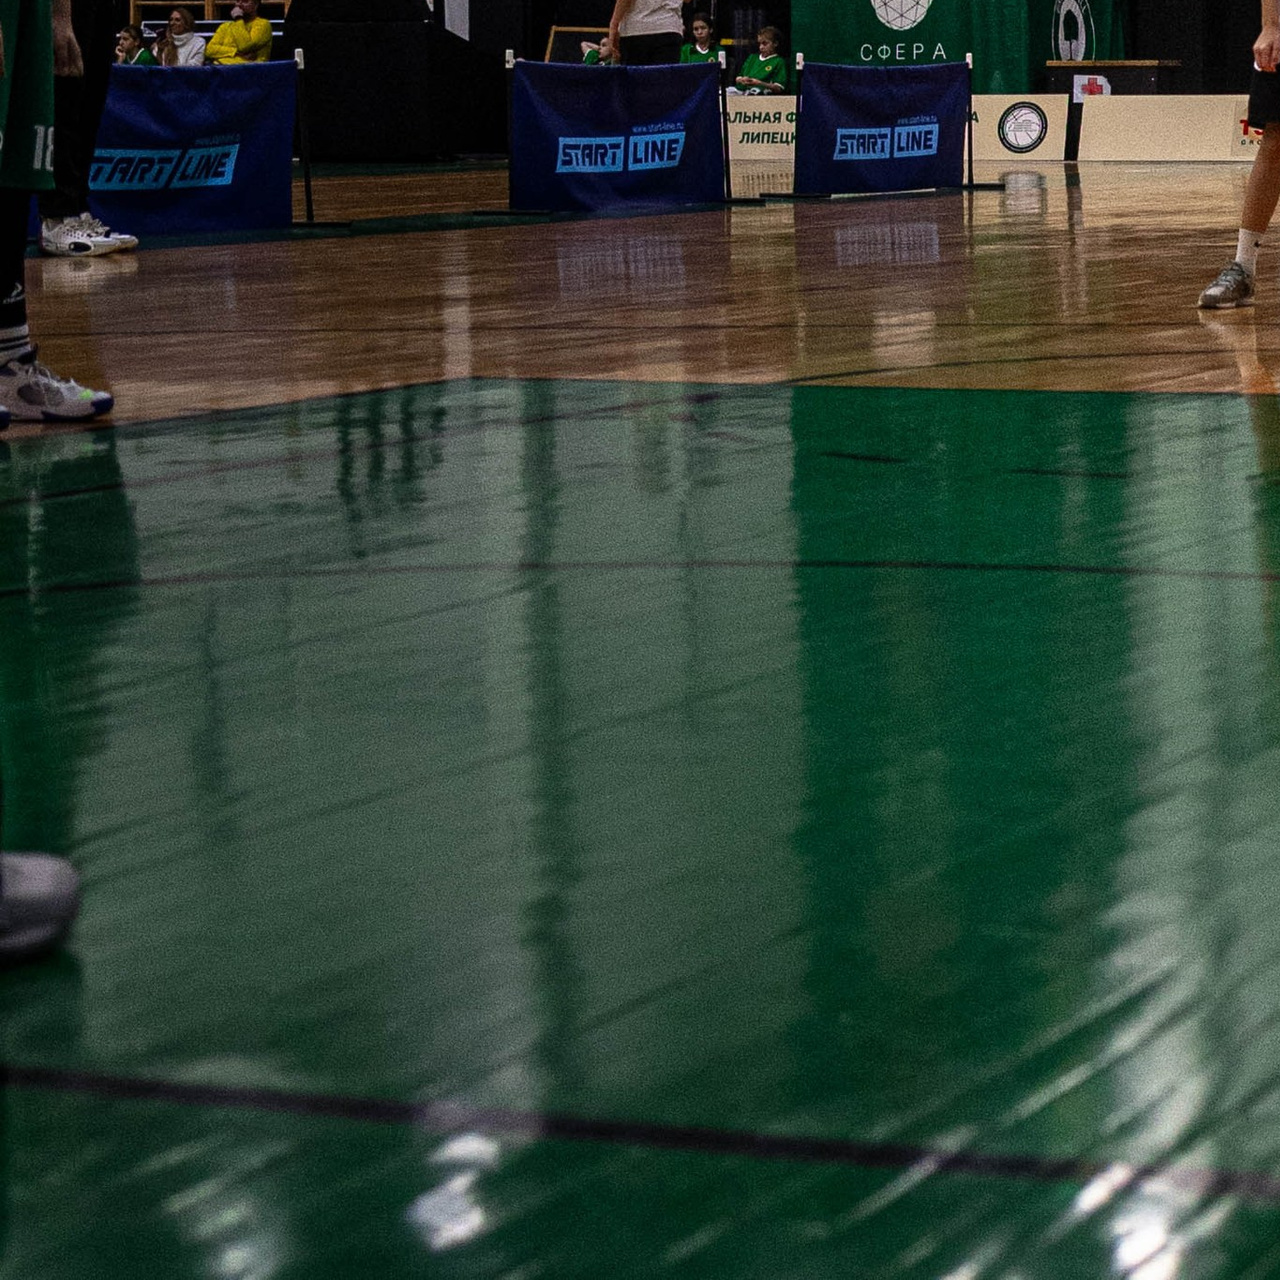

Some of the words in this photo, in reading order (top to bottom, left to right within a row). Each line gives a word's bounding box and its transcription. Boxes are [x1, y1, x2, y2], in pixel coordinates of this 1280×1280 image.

[860, 42, 947, 61] СФЕРА
[561, 143, 621, 166] START
[632, 138, 680, 164] LINE
[837, 133, 889, 155] START
[897, 130, 934, 153] LINE
[91, 156, 174, 184] TART
[179, 152, 231, 181] LINE
